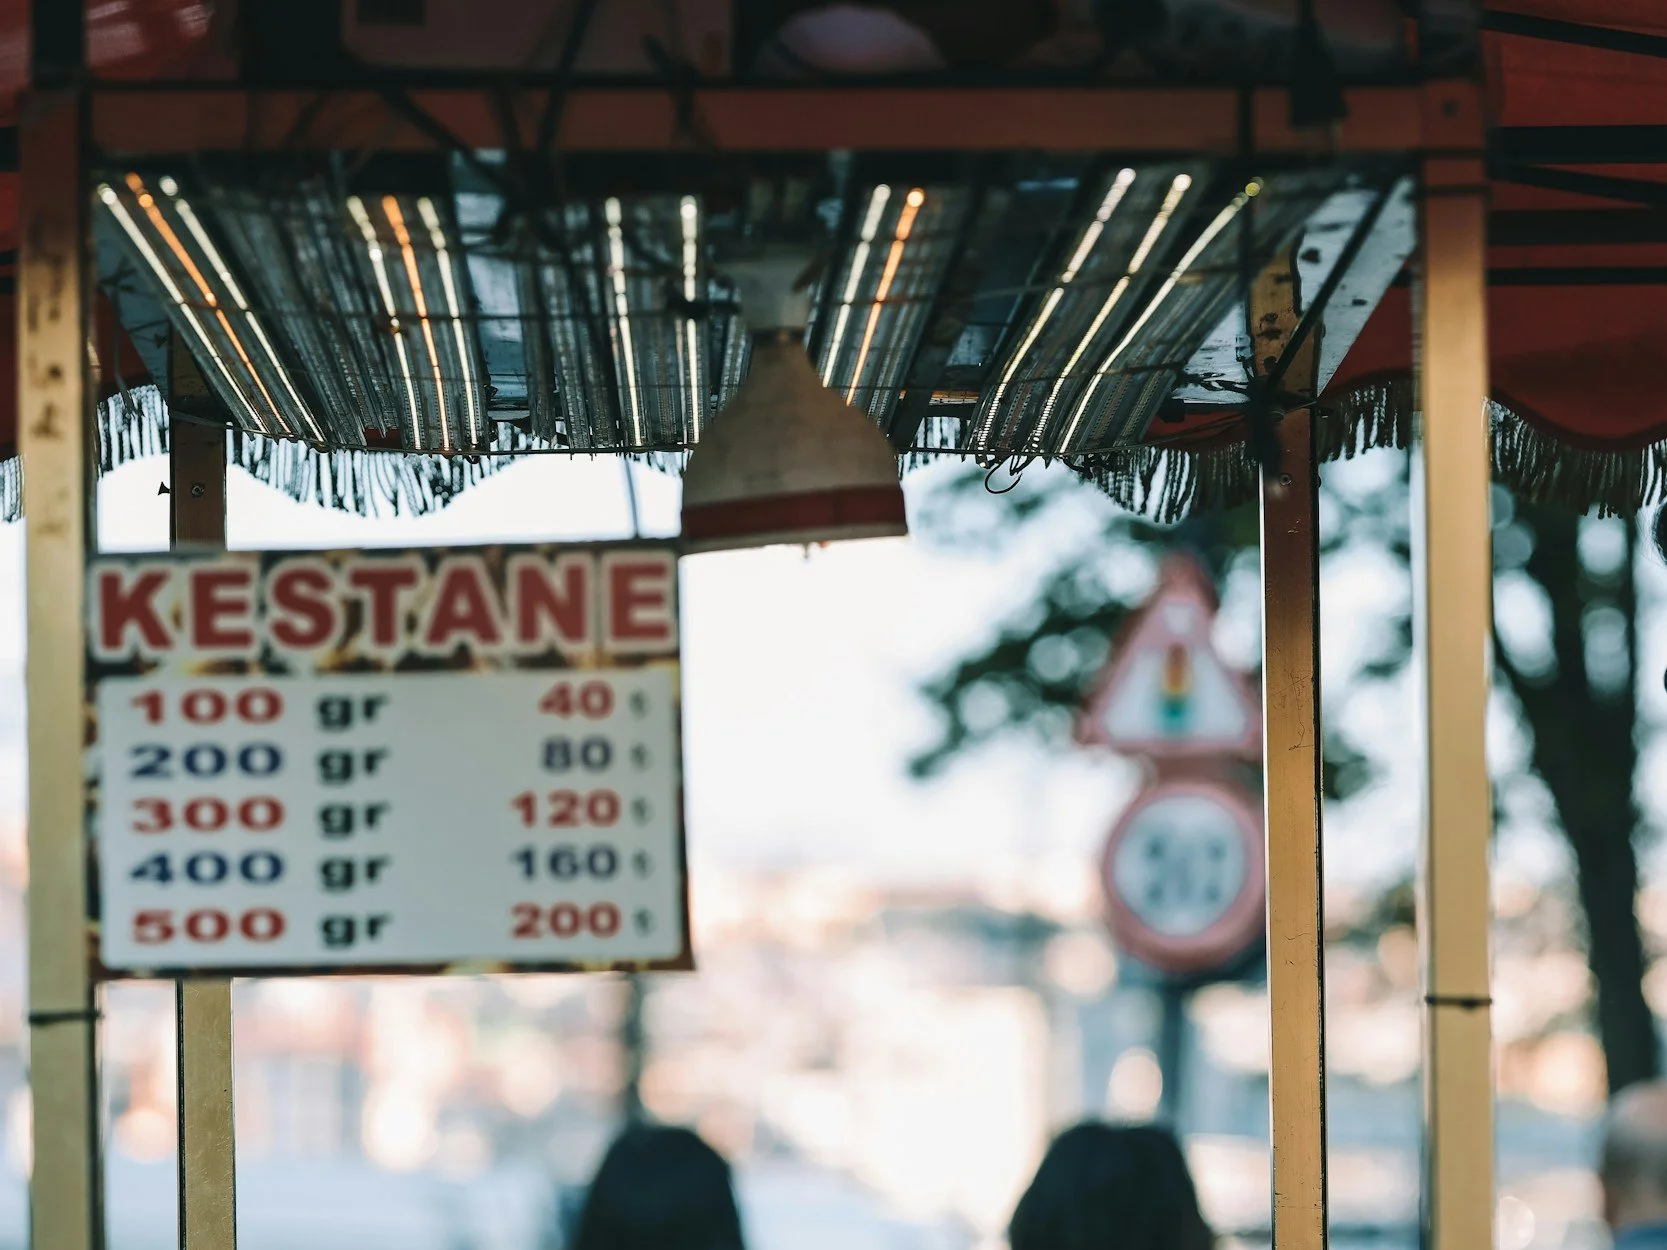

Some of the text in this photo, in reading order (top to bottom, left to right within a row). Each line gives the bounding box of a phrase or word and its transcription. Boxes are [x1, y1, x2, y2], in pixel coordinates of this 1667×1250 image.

[100, 562, 671, 650] KESTANE
[133, 687, 284, 725] 100
[317, 692, 388, 732] gr
[538, 681, 615, 719] 40
[131, 743, 284, 778] 200
[318, 748, 388, 786] gr
[541, 736, 614, 773] 80
[133, 796, 285, 833] 300
[319, 801, 389, 839] gr
[512, 790, 621, 828] 120
[131, 851, 285, 885] 400
[320, 855, 389, 893] gr
[512, 845, 620, 880] 160
[134, 908, 286, 944] 500
[320, 913, 390, 949] gr
[512, 902, 621, 939] 200
